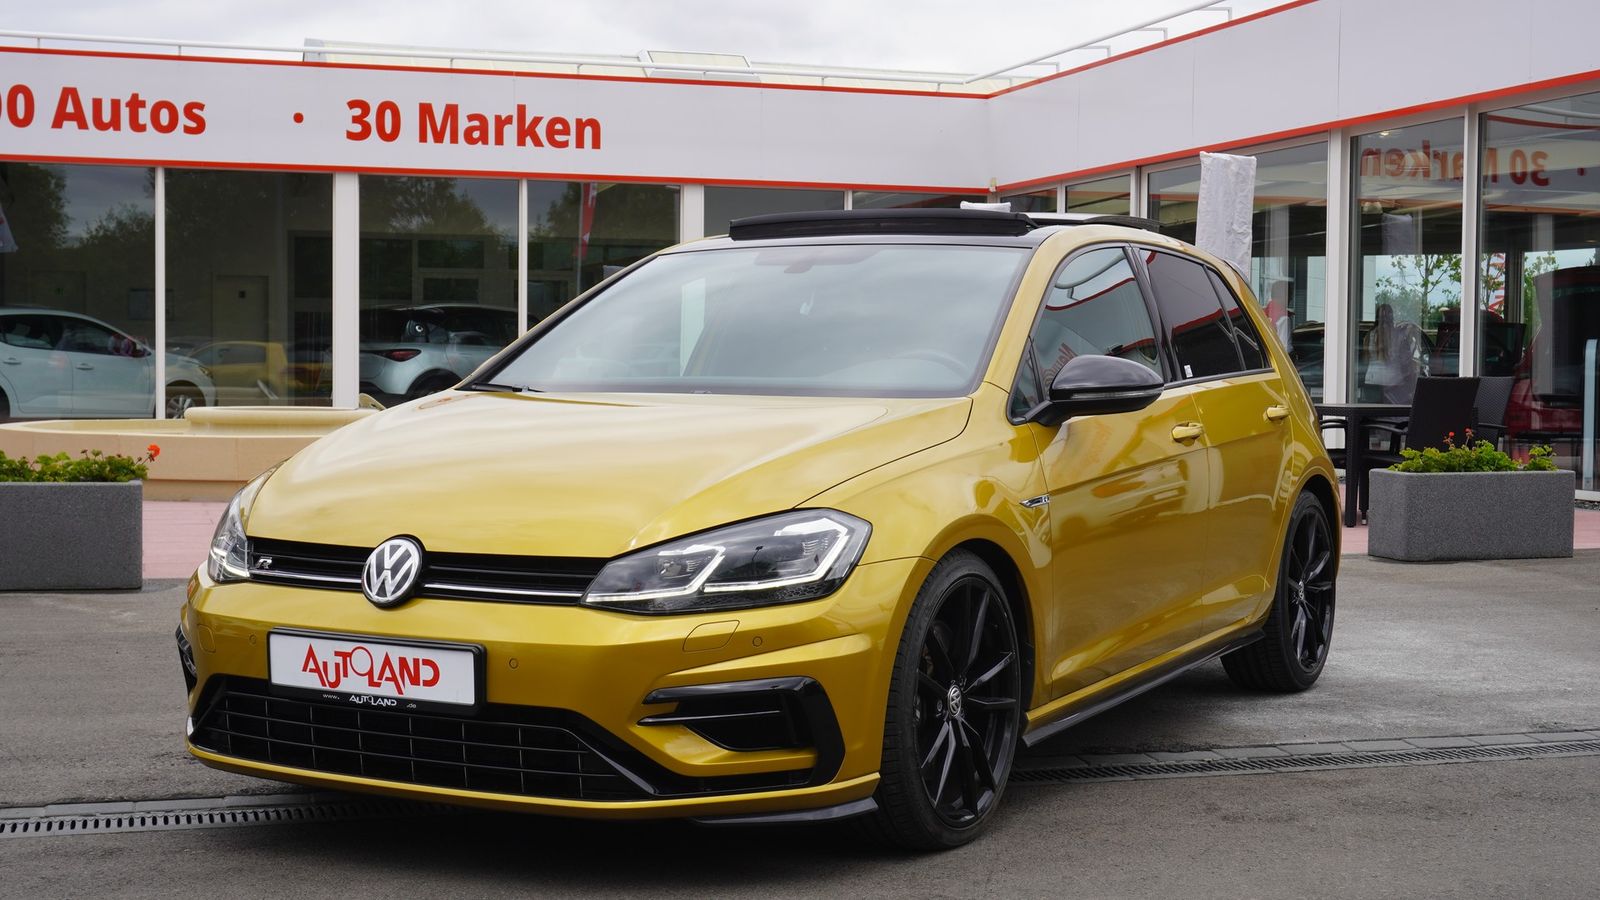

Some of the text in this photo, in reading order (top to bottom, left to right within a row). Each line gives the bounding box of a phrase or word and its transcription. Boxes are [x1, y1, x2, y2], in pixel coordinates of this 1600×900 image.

[0, 84, 602, 150] 0 Autos 30 Marken
[363, 538, 420, 602] VW
[302, 643, 440, 696] AUTOLAND
[349, 694, 397, 707] AUTOLAND
